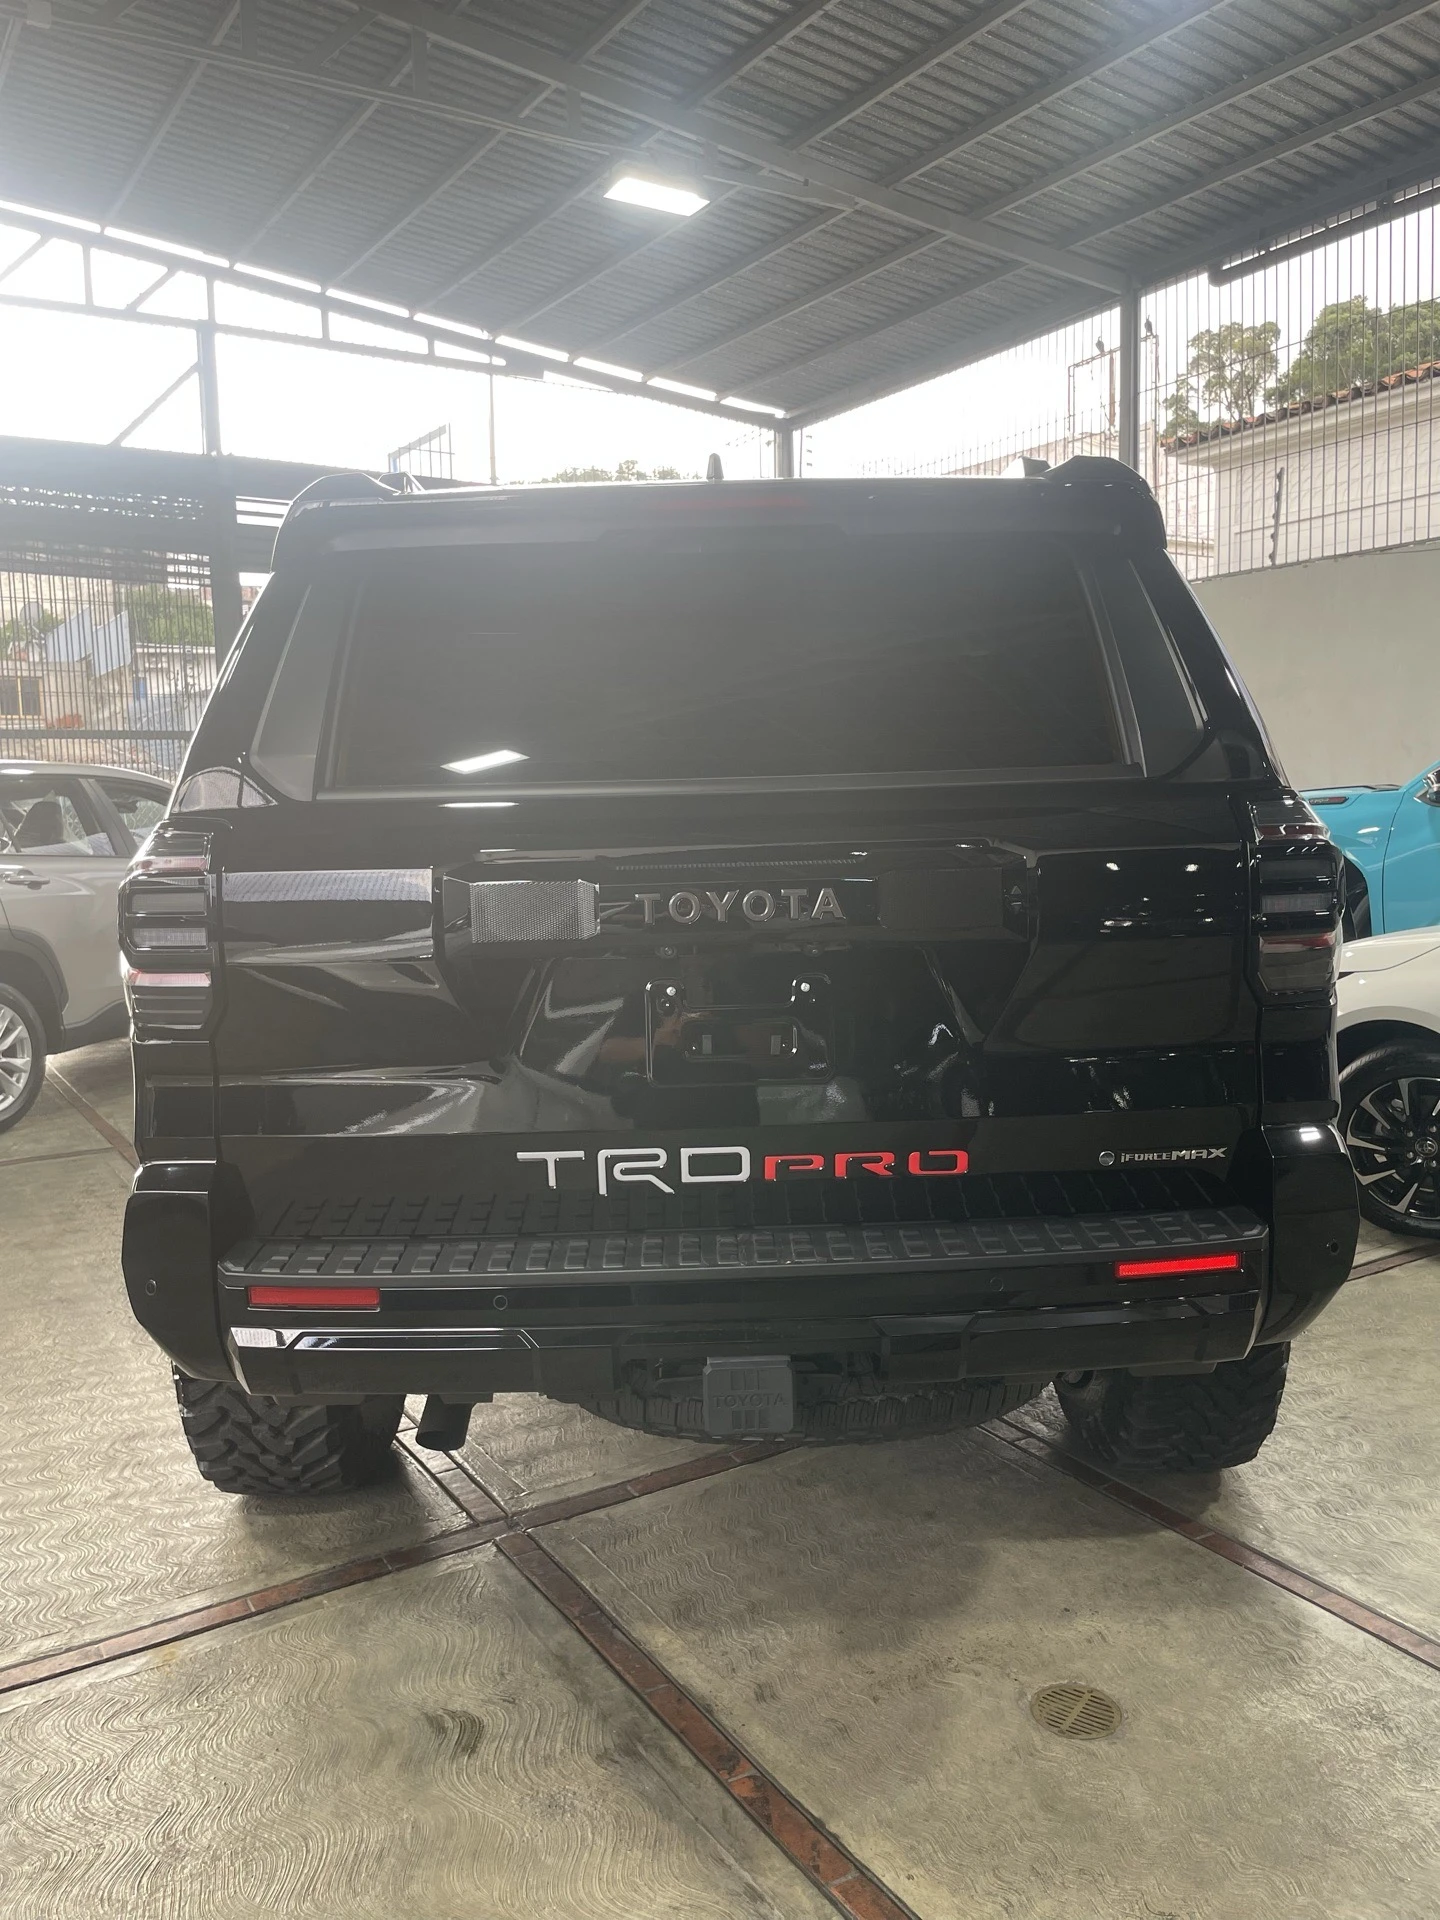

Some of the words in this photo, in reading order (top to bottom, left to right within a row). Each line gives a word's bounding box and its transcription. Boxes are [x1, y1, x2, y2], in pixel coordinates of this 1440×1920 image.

[634, 887, 846, 926] TOYOTA
[516, 1145, 751, 1196] TRD
[764, 1149, 969, 1182] PRO
[712, 1393, 787, 1409] TOYOTA
